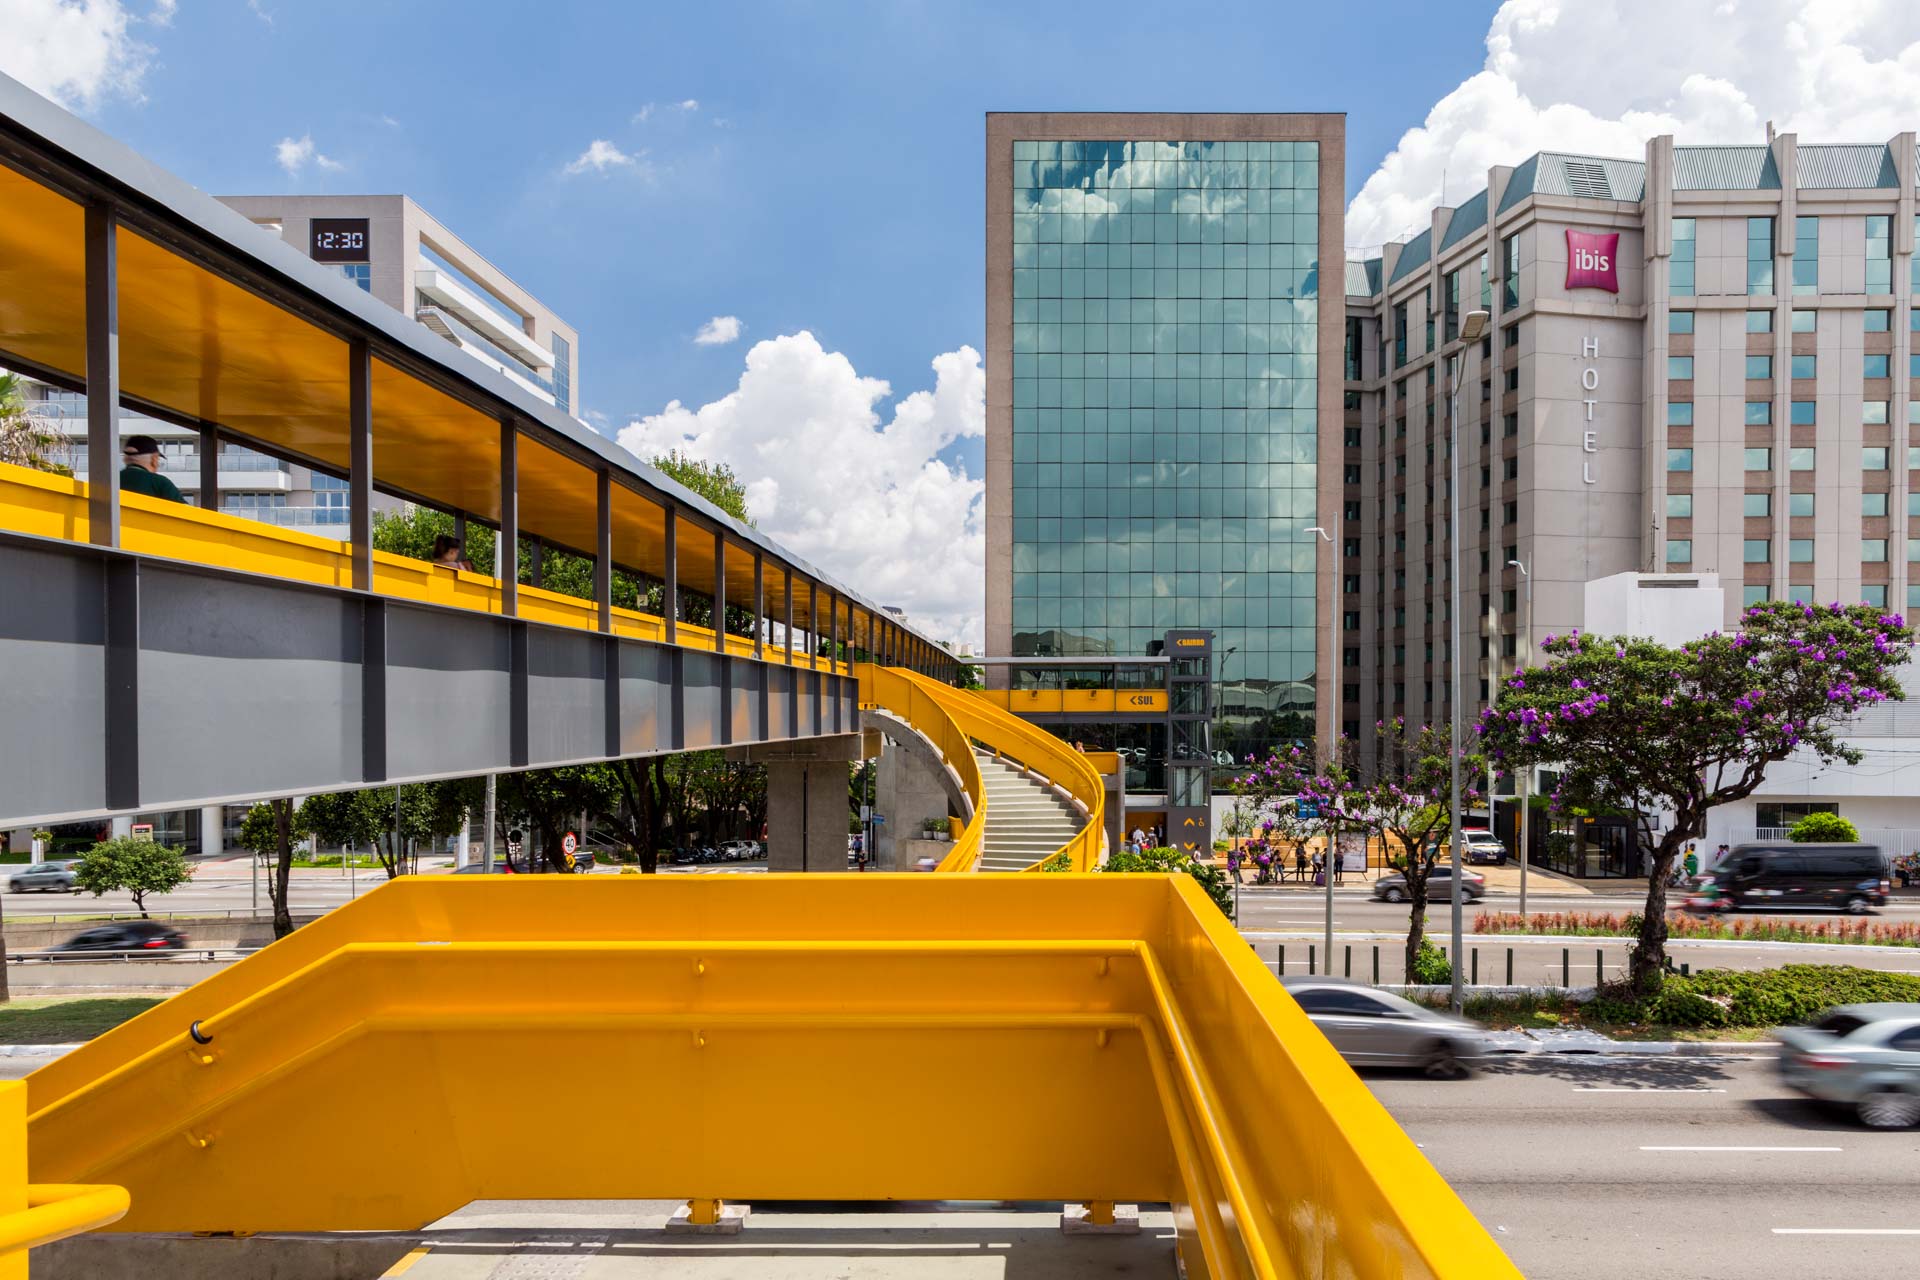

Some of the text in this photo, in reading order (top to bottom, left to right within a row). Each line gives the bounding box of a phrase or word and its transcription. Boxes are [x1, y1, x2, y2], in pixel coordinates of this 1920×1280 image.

[317, 232, 363, 249] 12:30
[1575, 248, 1610, 272] ibis
[1582, 336, 1599, 484] HOTEL
[1138, 695, 1154, 705] SUL
[566, 839, 574, 848] 40
